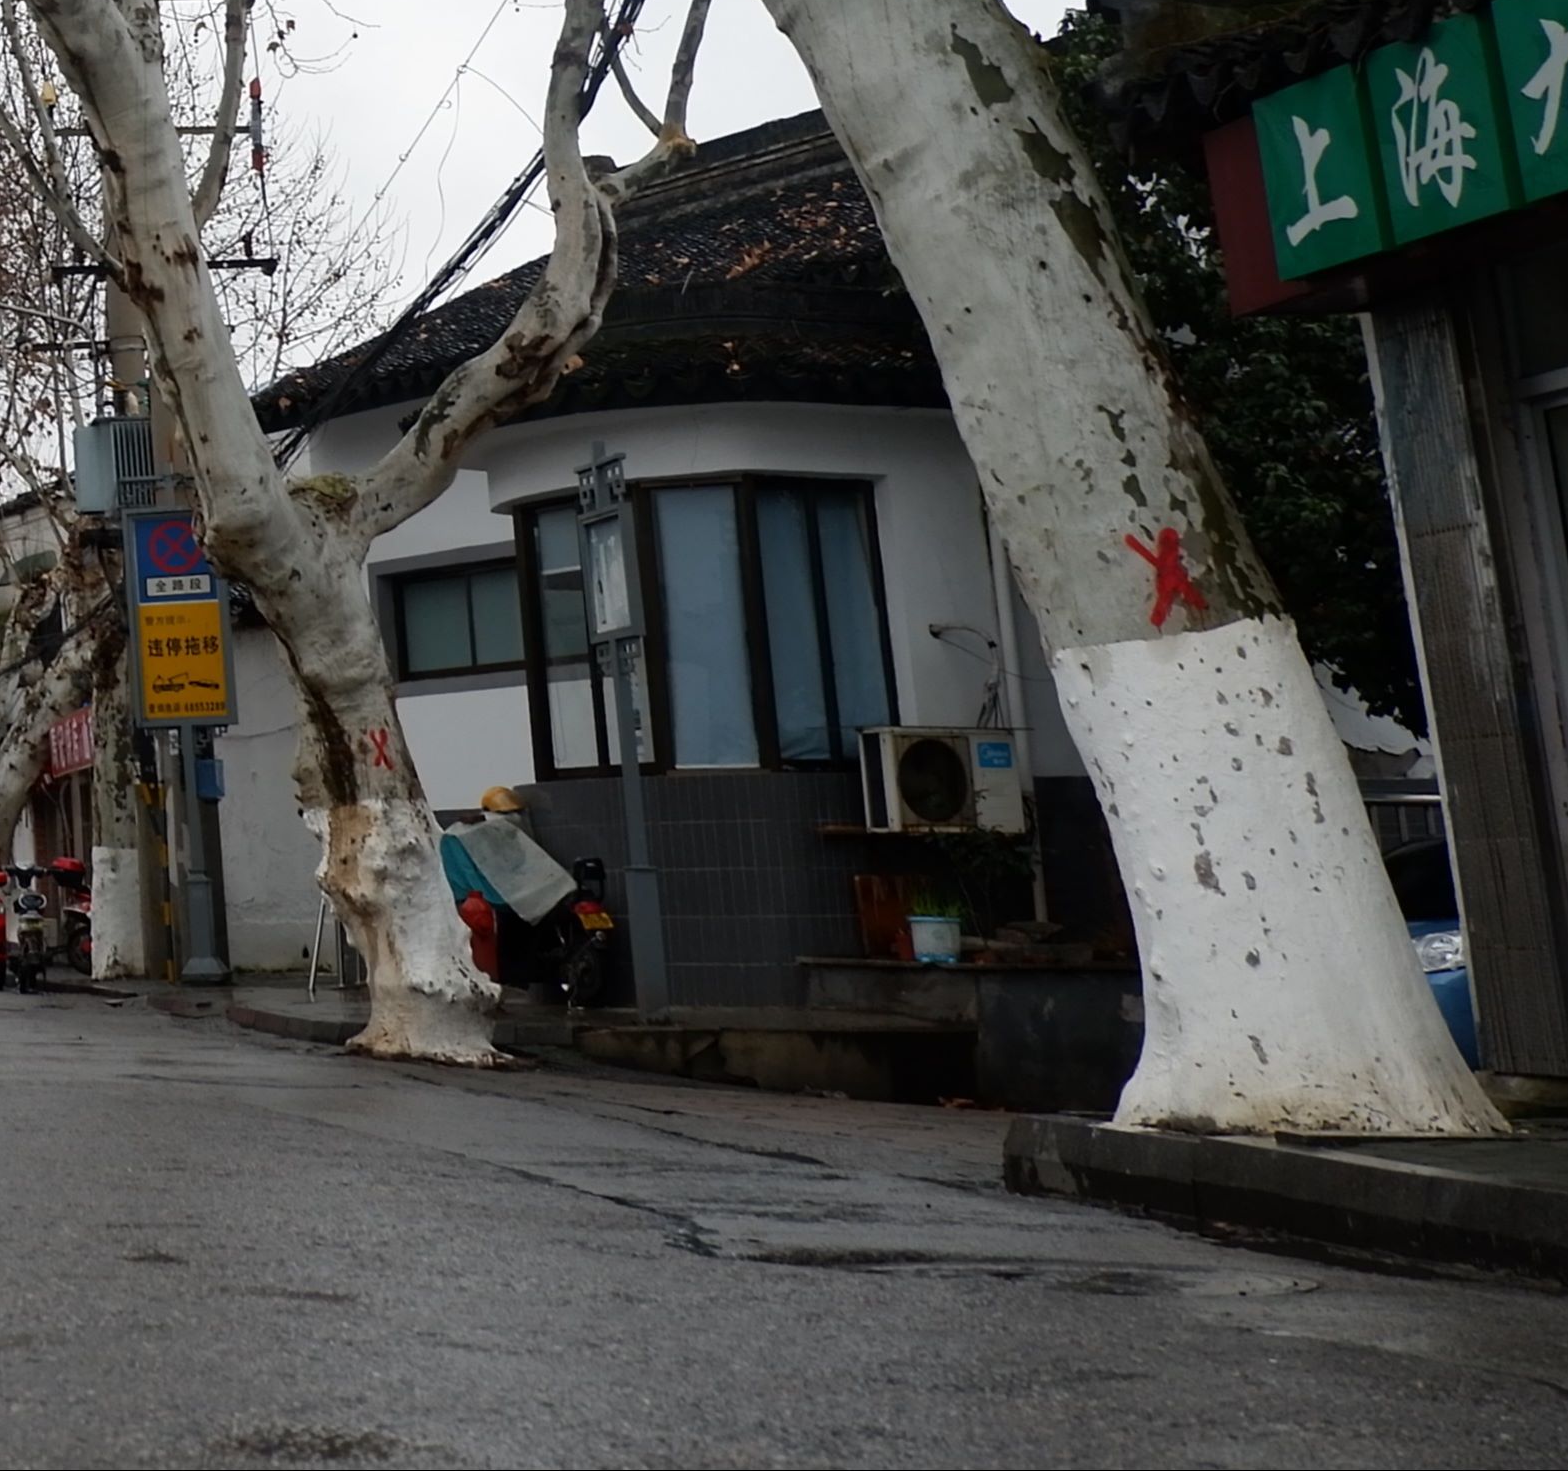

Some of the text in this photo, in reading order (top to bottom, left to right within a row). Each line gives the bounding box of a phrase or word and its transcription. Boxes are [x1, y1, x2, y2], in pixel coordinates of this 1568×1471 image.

[155, 578, 202, 593] 全路段
[148, 635, 220, 657] 违停拖移
